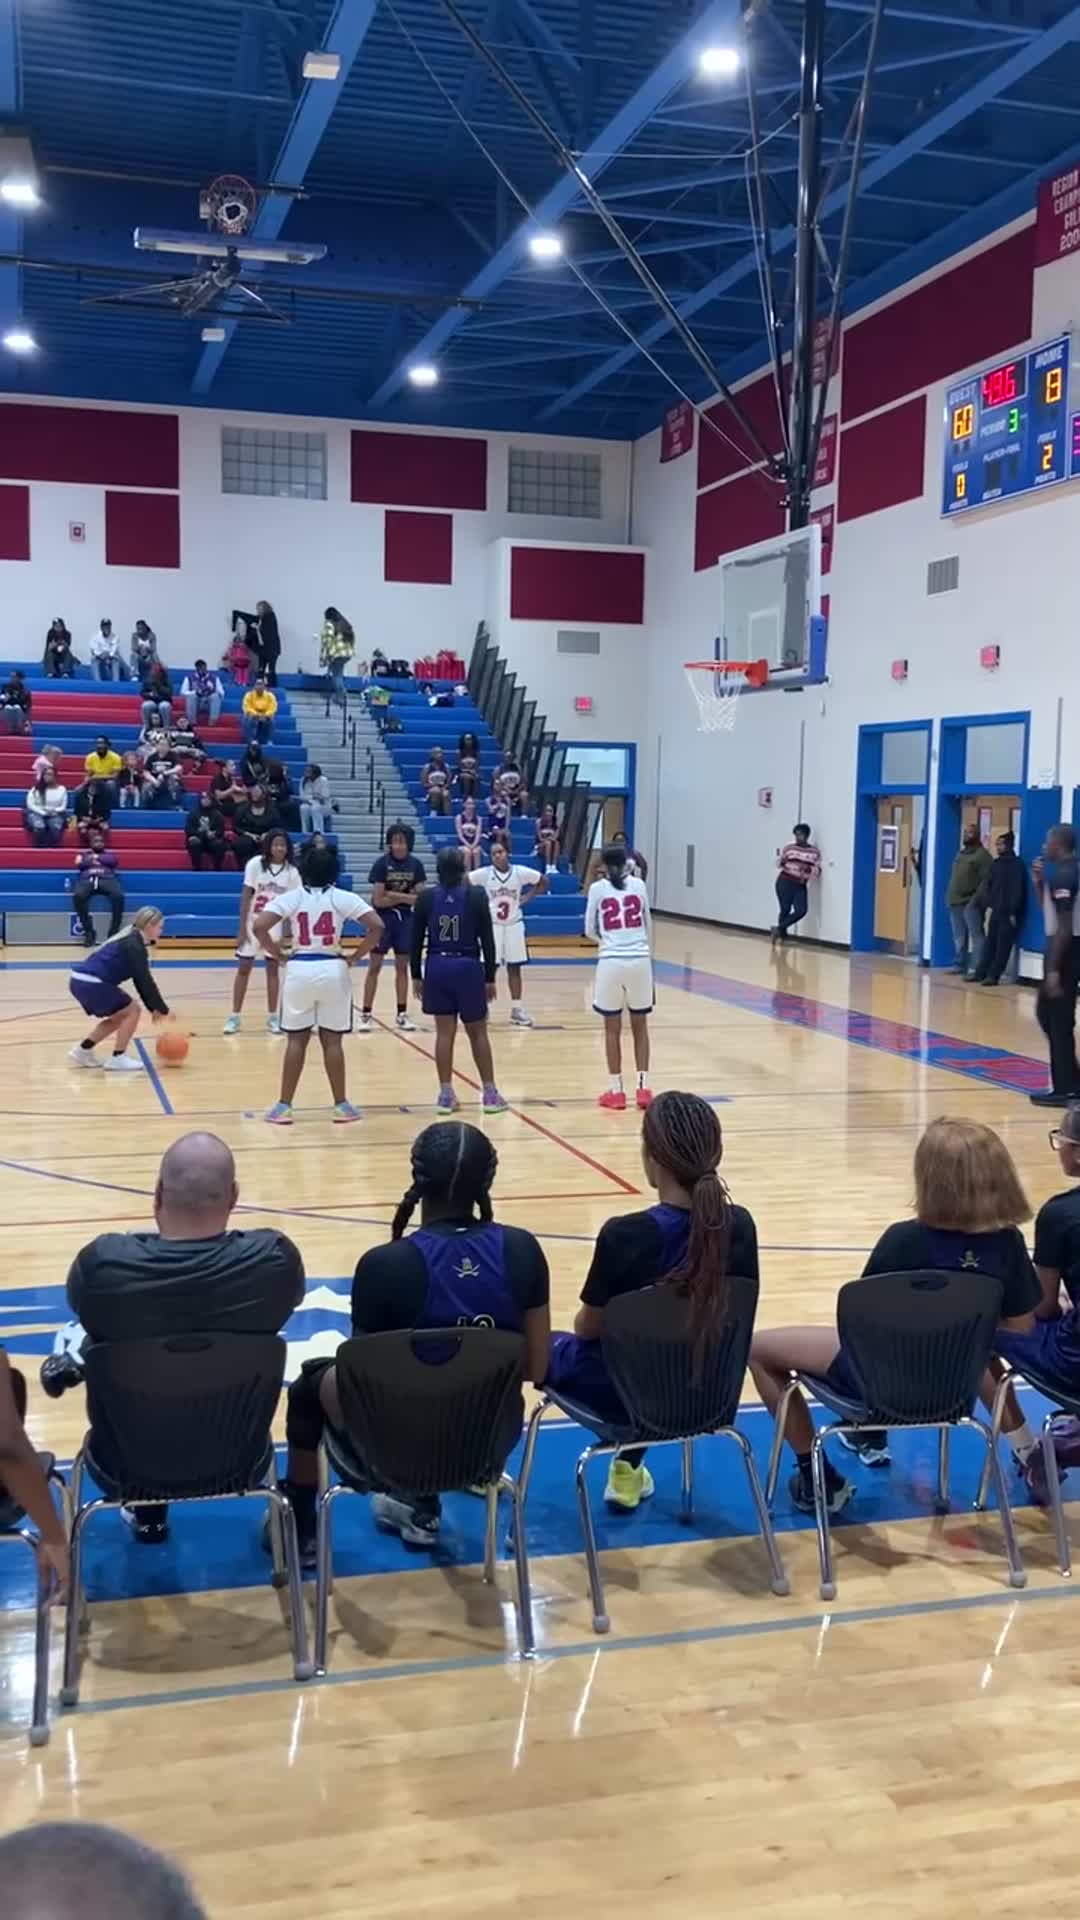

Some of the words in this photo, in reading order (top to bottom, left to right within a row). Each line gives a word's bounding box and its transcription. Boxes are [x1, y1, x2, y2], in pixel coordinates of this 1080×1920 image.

[1009, 408, 1018, 432] 3
[1042, 443, 1053, 470] 2
[496, 901, 510, 920] 3
[601, 894, 642, 931] 22
[297, 911, 335, 946] 14
[439, 914, 460, 942] 21
